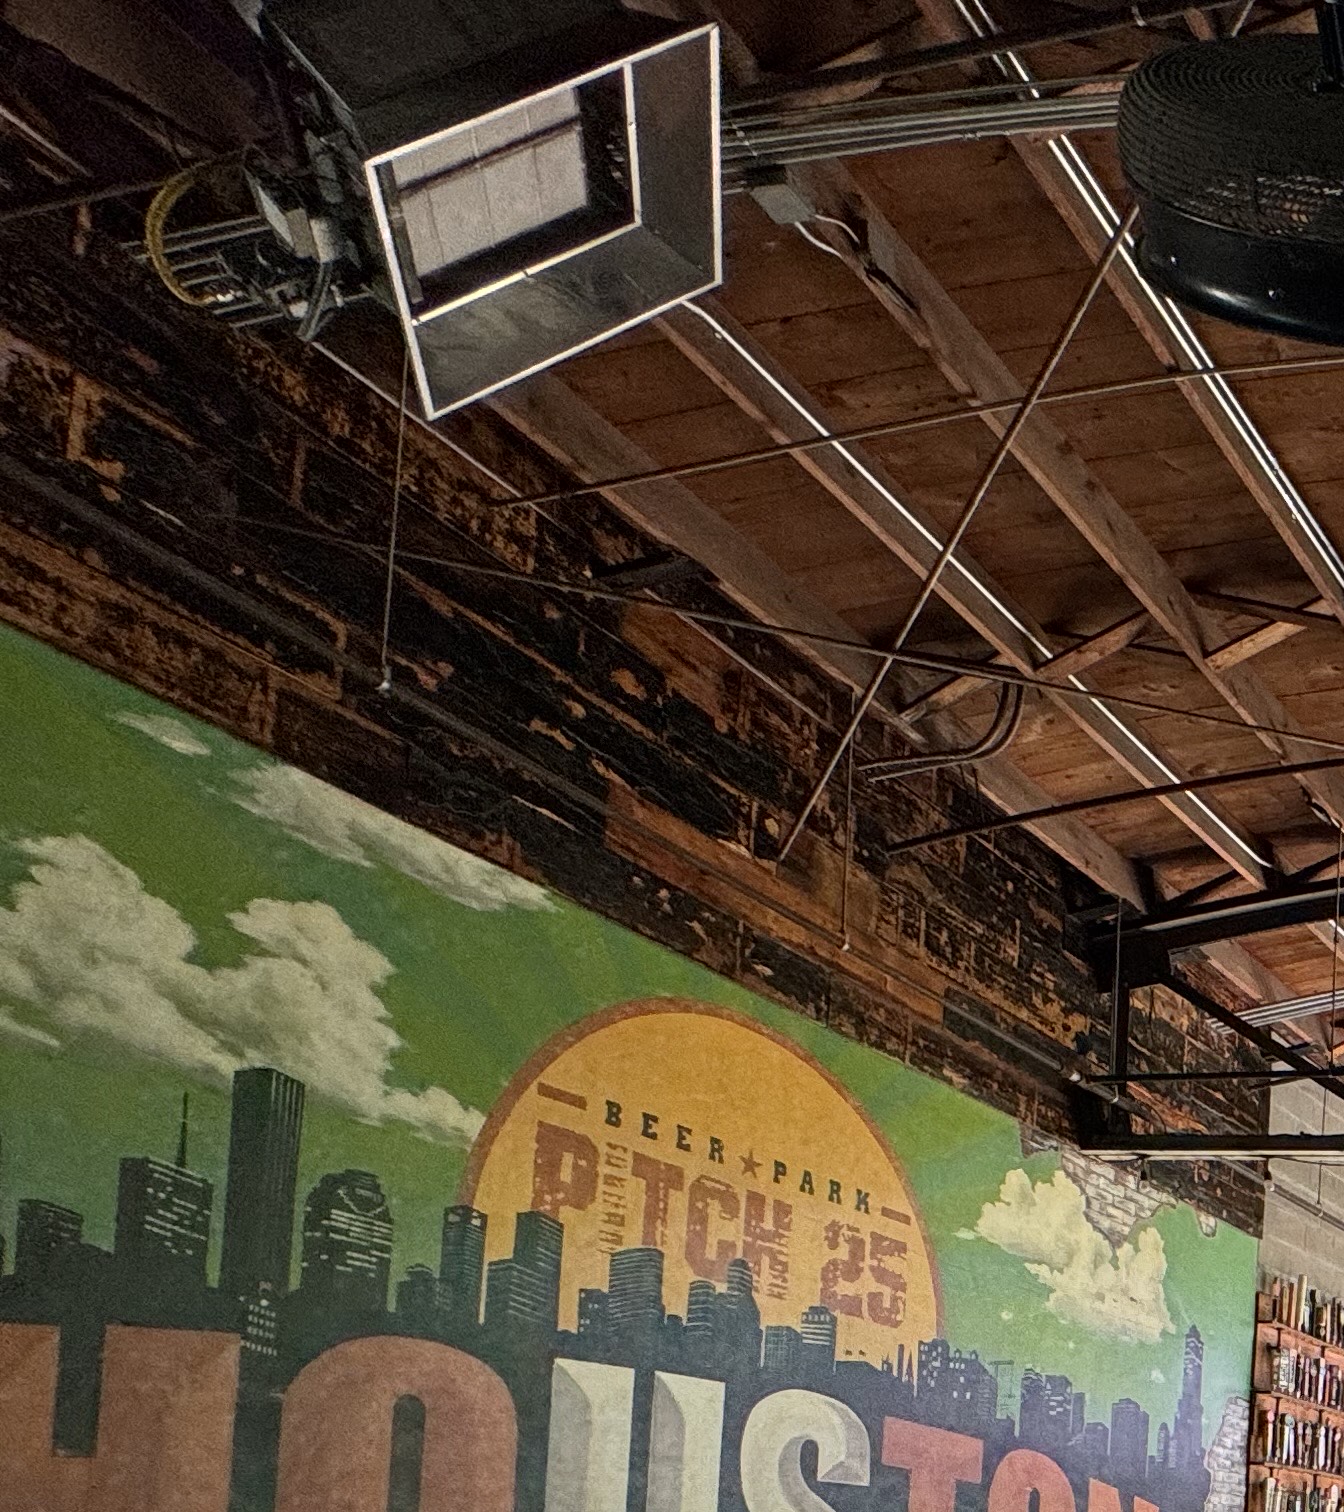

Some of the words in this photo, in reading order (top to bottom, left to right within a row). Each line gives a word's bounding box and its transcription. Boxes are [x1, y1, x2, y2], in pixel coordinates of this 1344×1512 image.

[605, 1099, 724, 1165] BEER
[773, 1160, 870, 1215] PARK
[820, 1219, 908, 1329] 25
